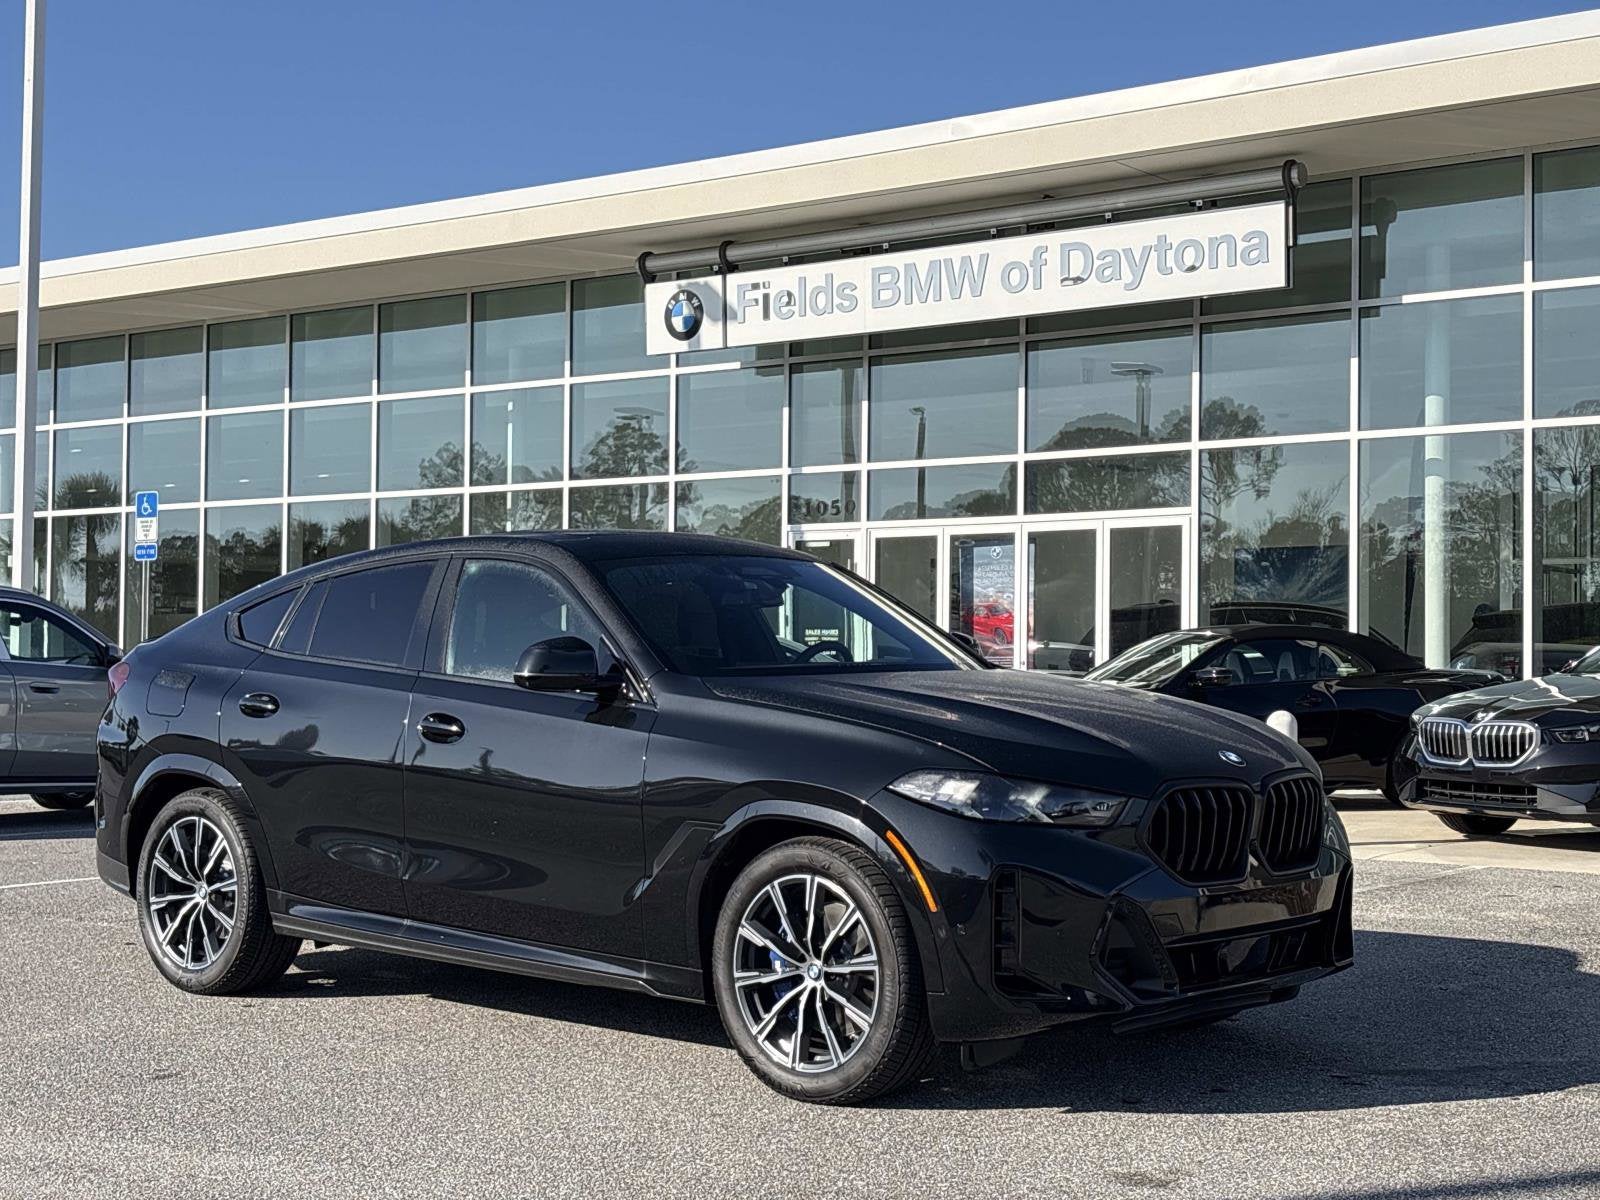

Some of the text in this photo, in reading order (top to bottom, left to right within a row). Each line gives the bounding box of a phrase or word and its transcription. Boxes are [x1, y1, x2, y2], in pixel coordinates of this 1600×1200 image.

[737, 230, 1270, 324] Fields BMW of Daytona
[668, 292, 700, 310] BMW
[804, 498, 856, 516] 1050
